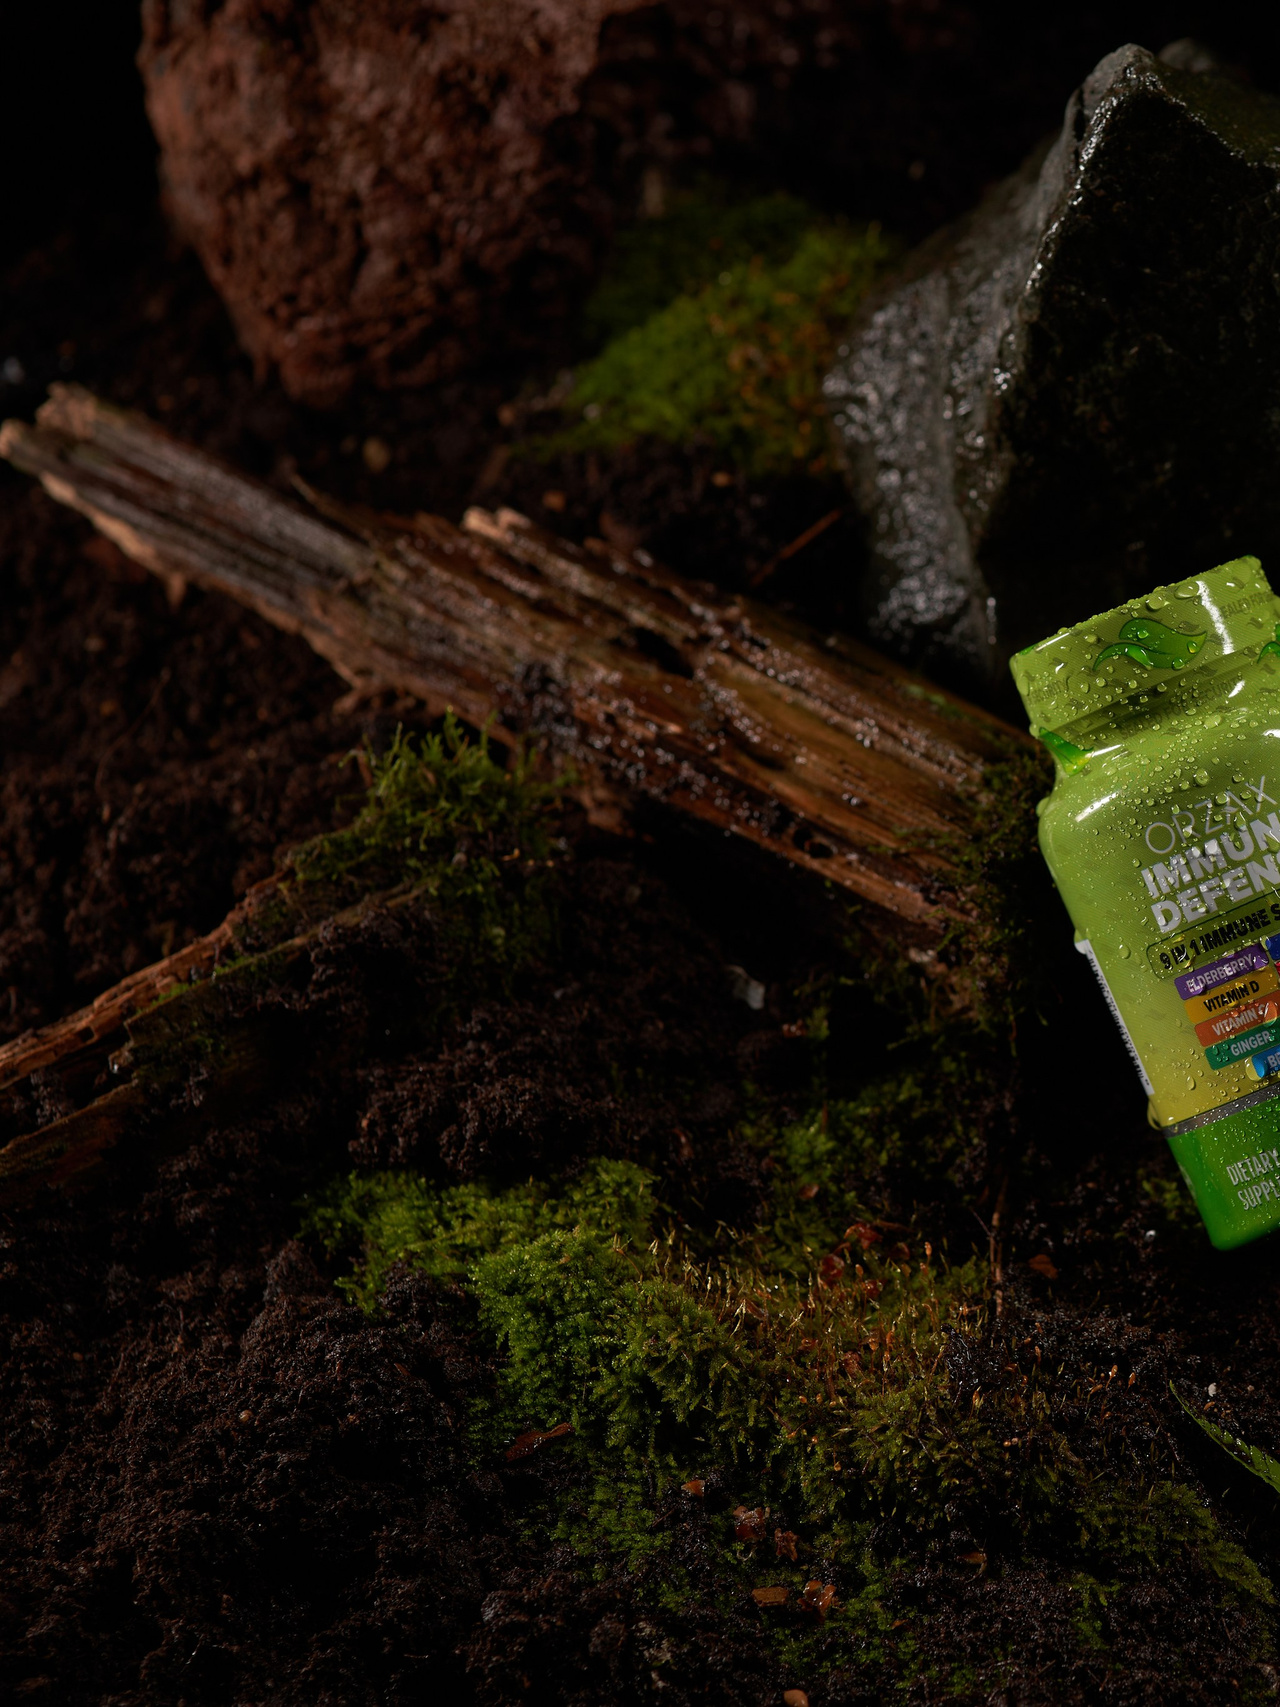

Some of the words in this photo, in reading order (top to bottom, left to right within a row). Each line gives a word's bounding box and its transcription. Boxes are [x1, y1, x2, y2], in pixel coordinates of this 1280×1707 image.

[1145, 775, 1278, 854] ORZAX
[1160, 952, 1174, 971] 9
[1173, 945, 1191, 966] IN
[1190, 939, 1201, 958] 1
[1199, 911, 1271, 954] IMMUNE
[1186, 952, 1254, 993] ELDERBERRY
[1203, 984, 1249, 1012] VITAMIN
[1249, 980, 1260, 995] D
[1211, 1009, 1258, 1037] VITAMIN
[1230, 1030, 1271, 1057] GINGER
